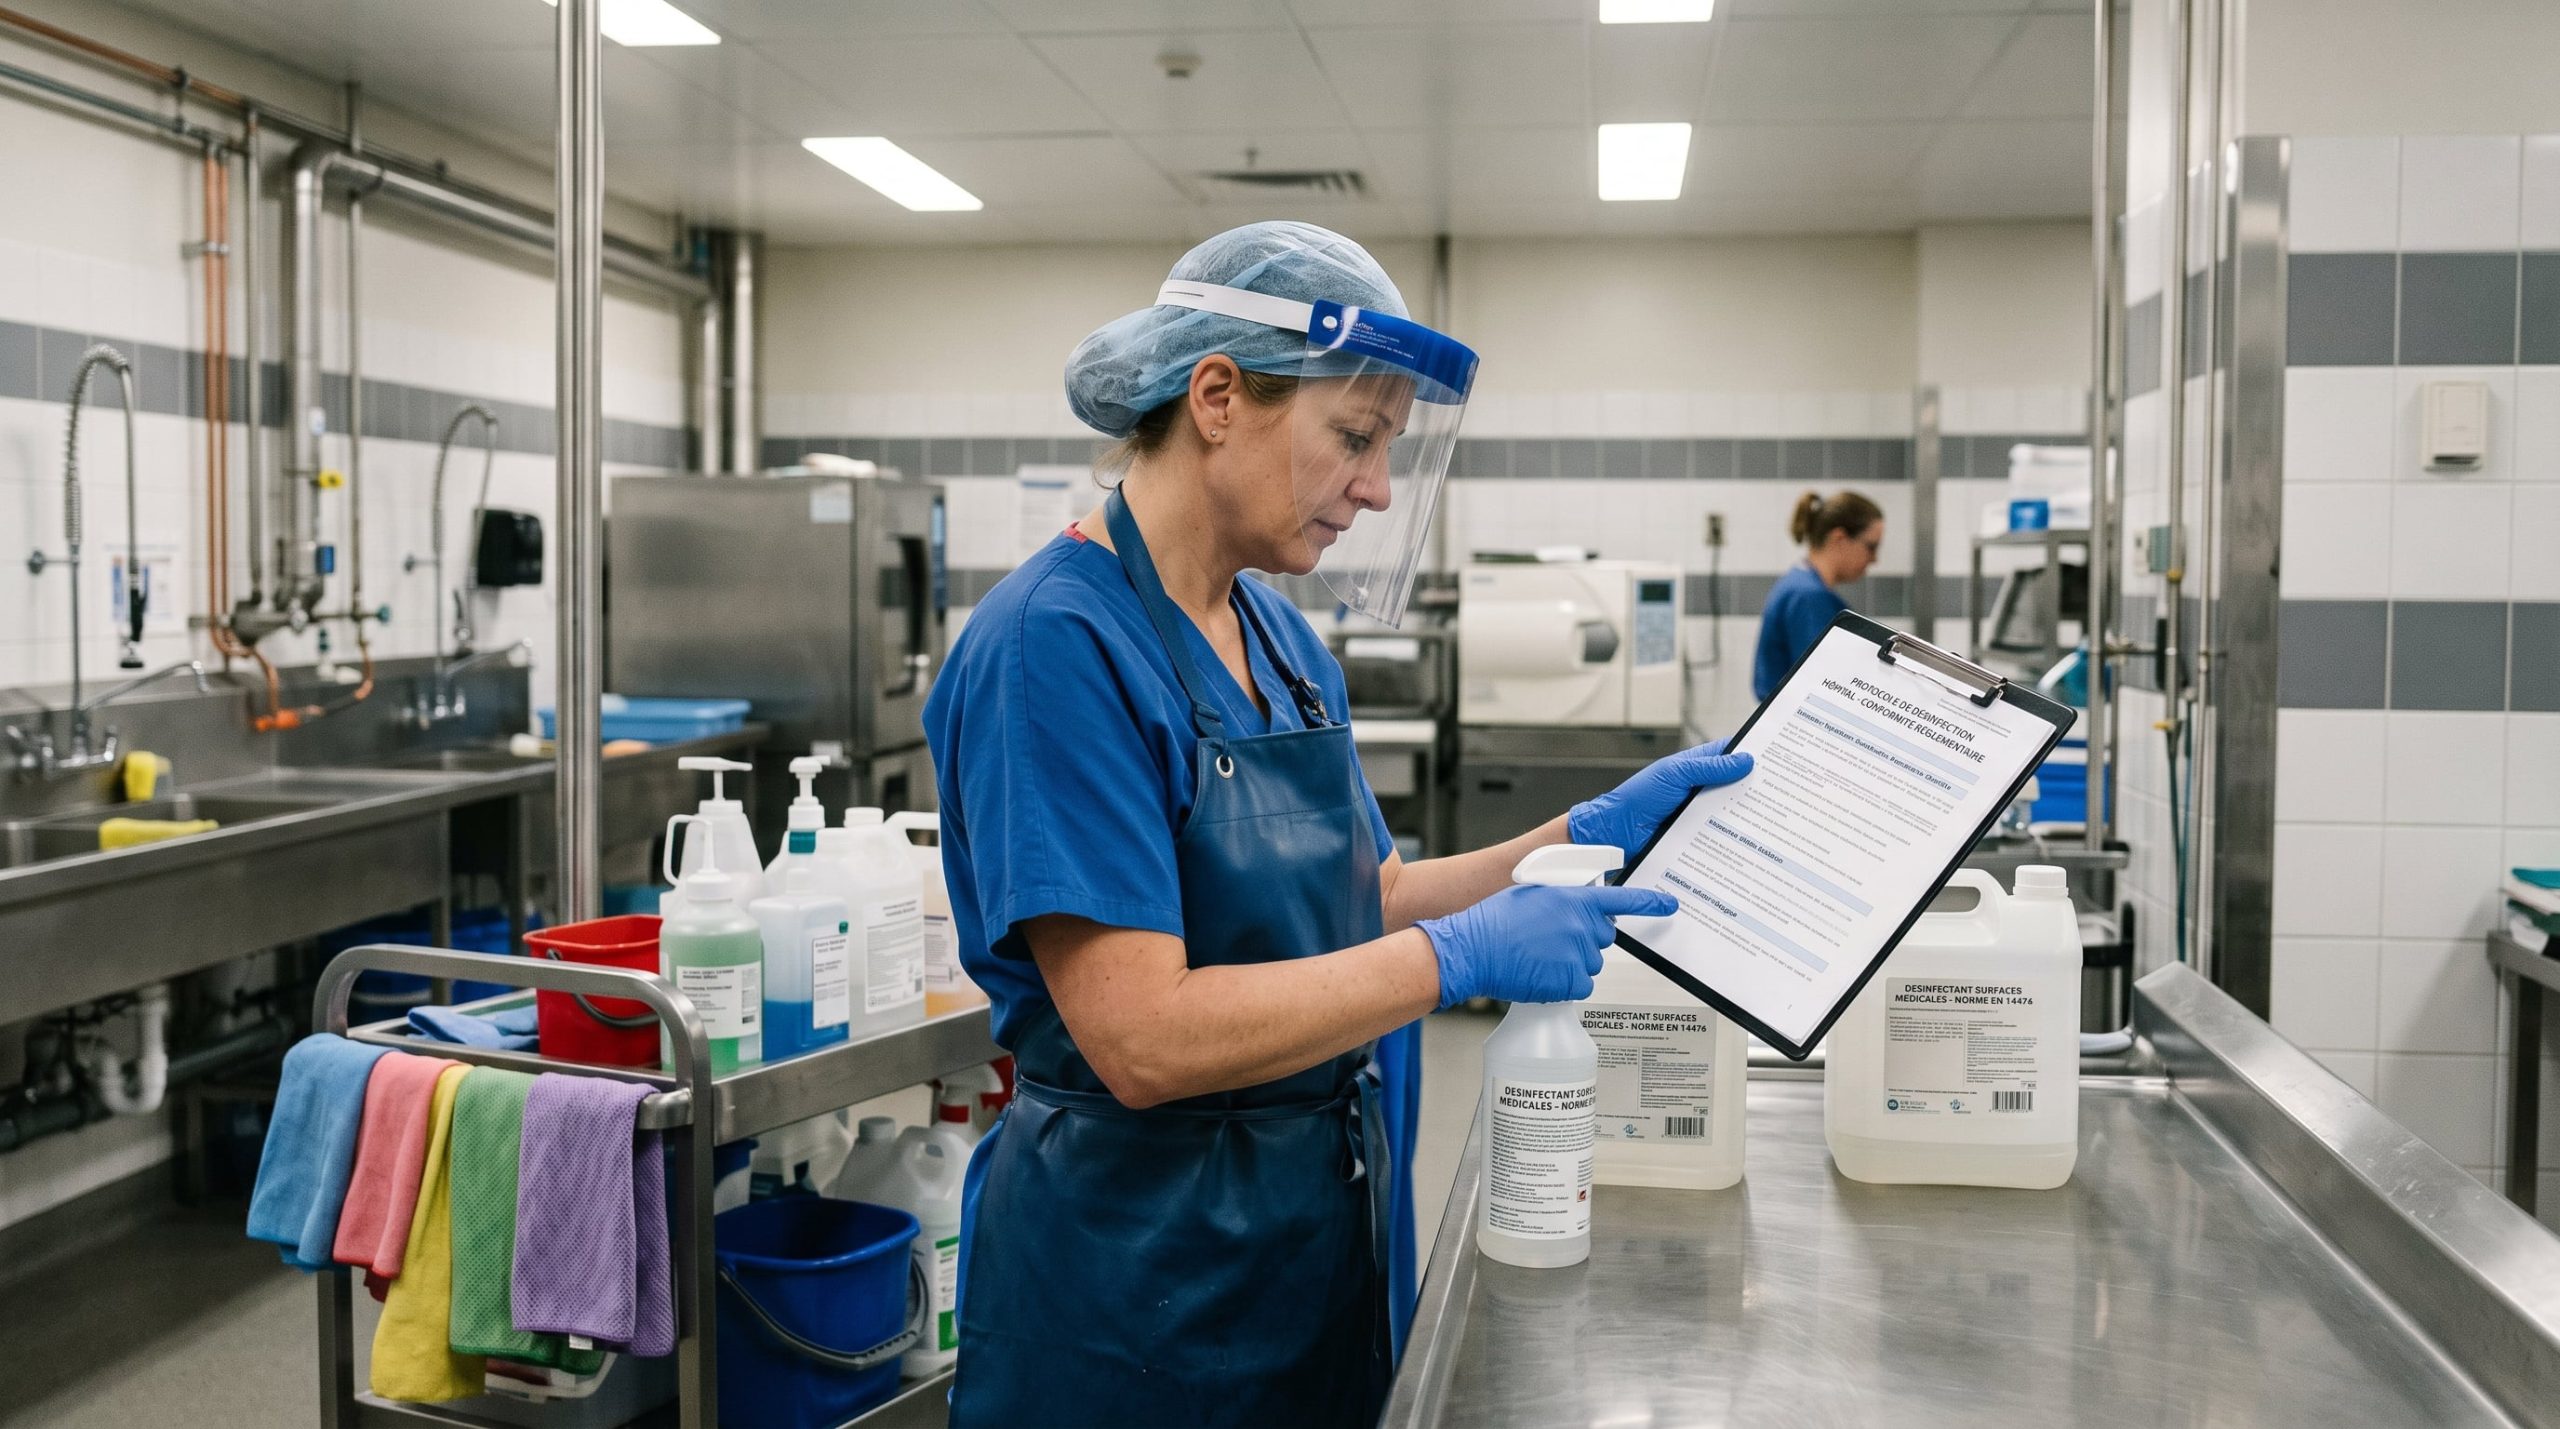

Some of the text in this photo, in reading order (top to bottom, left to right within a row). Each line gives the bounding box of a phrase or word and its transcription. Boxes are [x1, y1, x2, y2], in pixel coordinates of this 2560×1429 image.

[1904, 984, 2023, 996] DESINFECTANT SURFACES
[1894, 994, 1948, 1004] MEDICALES
[1955, 996, 1989, 1005] NORME
[1991, 997, 2003, 1005] EN
[2006, 997, 2033, 1006] 14476
[1652, 1013, 1697, 1022] SURFACES
[1581, 1020, 1624, 1030] EDICALES
[1631, 1022, 1664, 1031] NORME
[1666, 1023, 1679, 1032] EN
[1681, 1024, 1707, 1033] 14476
[1505, 1086, 1575, 1099] DESINFECTANT
[1500, 1096, 1552, 1110] MEDICALES
